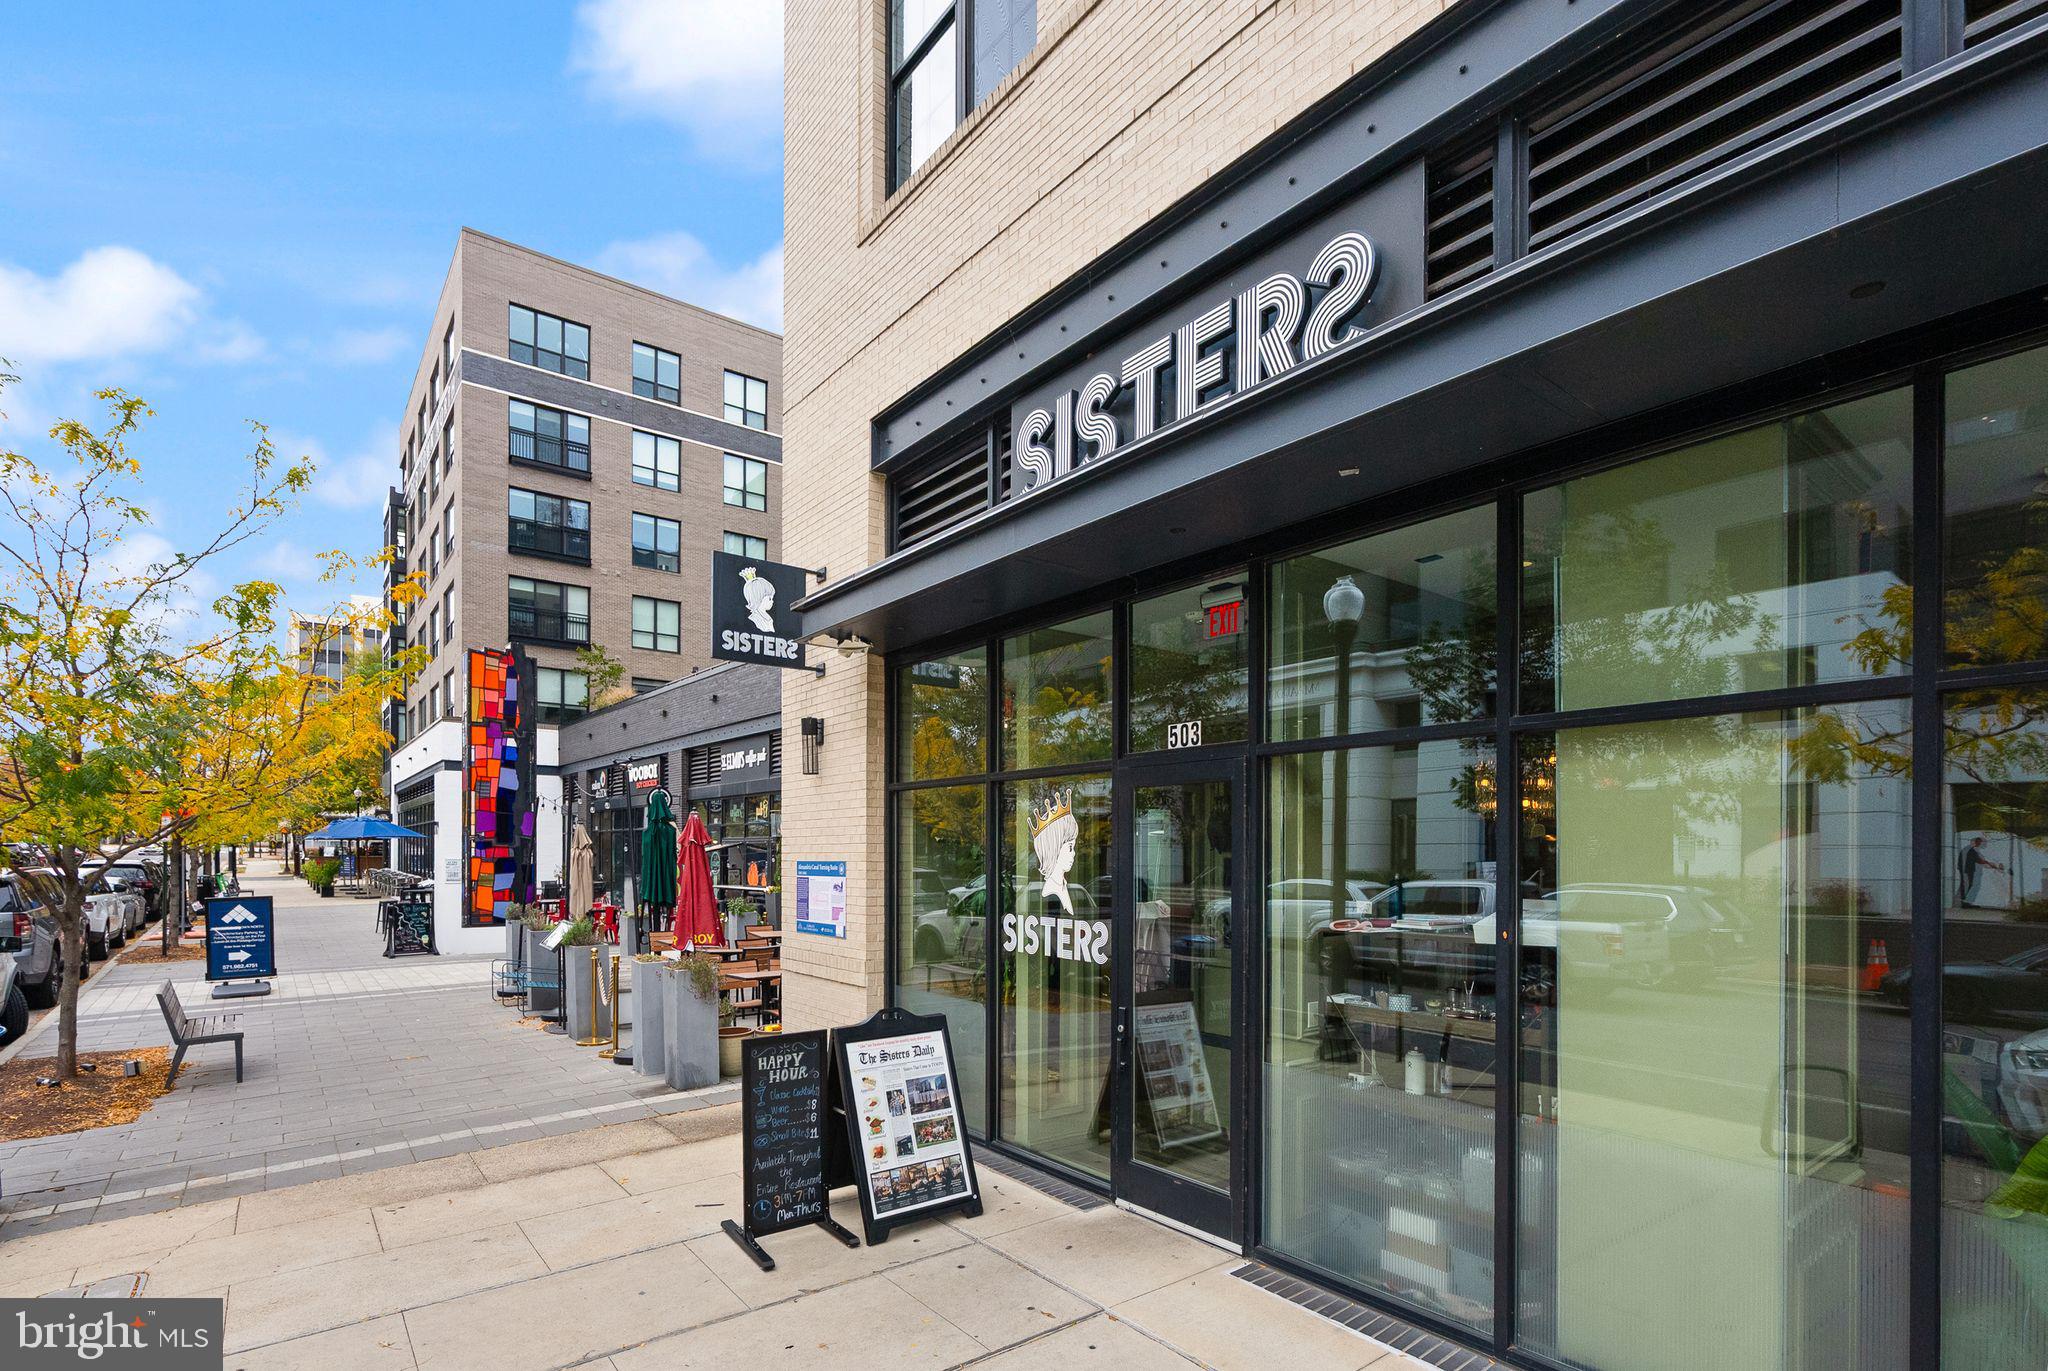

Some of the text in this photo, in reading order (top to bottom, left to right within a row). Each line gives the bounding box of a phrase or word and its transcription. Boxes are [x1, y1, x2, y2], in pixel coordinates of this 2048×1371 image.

[1016, 230, 1380, 496] SISTERS
[1210, 601, 1241, 637] EXIT
[722, 630, 798, 659] SISTERS
[1169, 722, 1200, 748] 503
[1003, 913, 1109, 965] SISTERS
[758, 1052, 804, 1070] HAPPY
[858, 1045, 935, 1065] The Sisters Daily
[769, 1066, 808, 1083] HOUR
[779, 1167, 793, 1177] the
